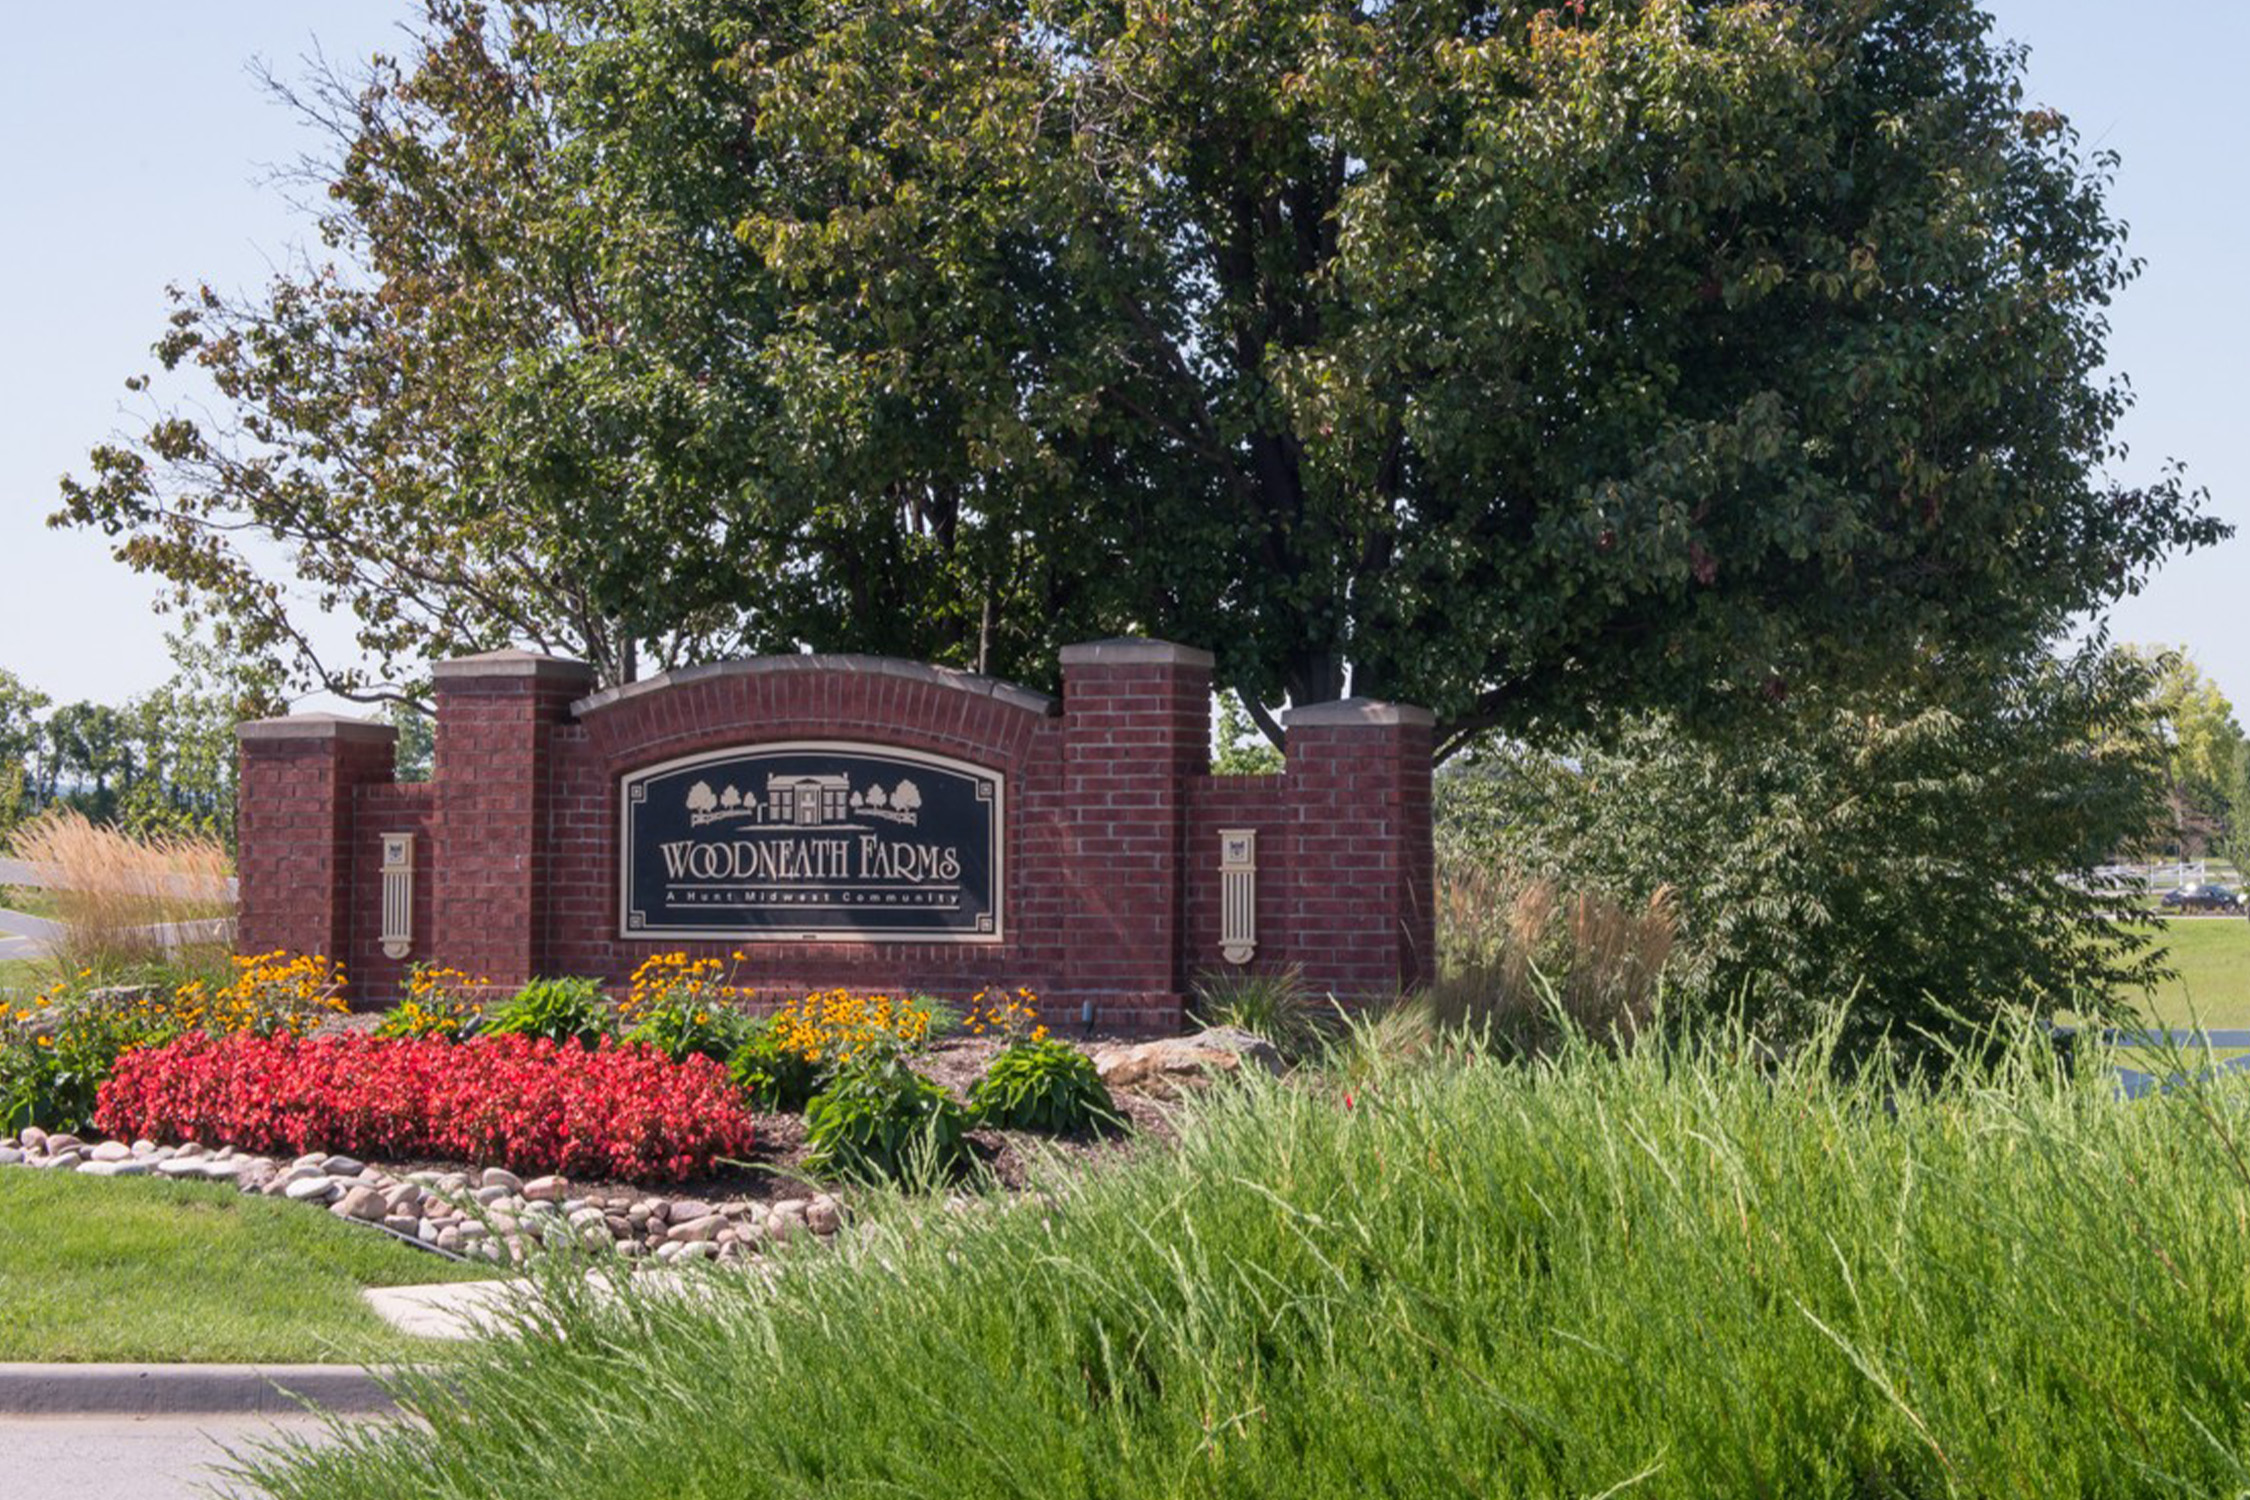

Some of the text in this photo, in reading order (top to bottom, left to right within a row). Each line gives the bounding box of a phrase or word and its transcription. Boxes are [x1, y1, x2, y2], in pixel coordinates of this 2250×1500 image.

[660, 834, 961, 882] WOODNEATH FARMS
[666, 892, 958, 903] A Hunt Midwest Community
